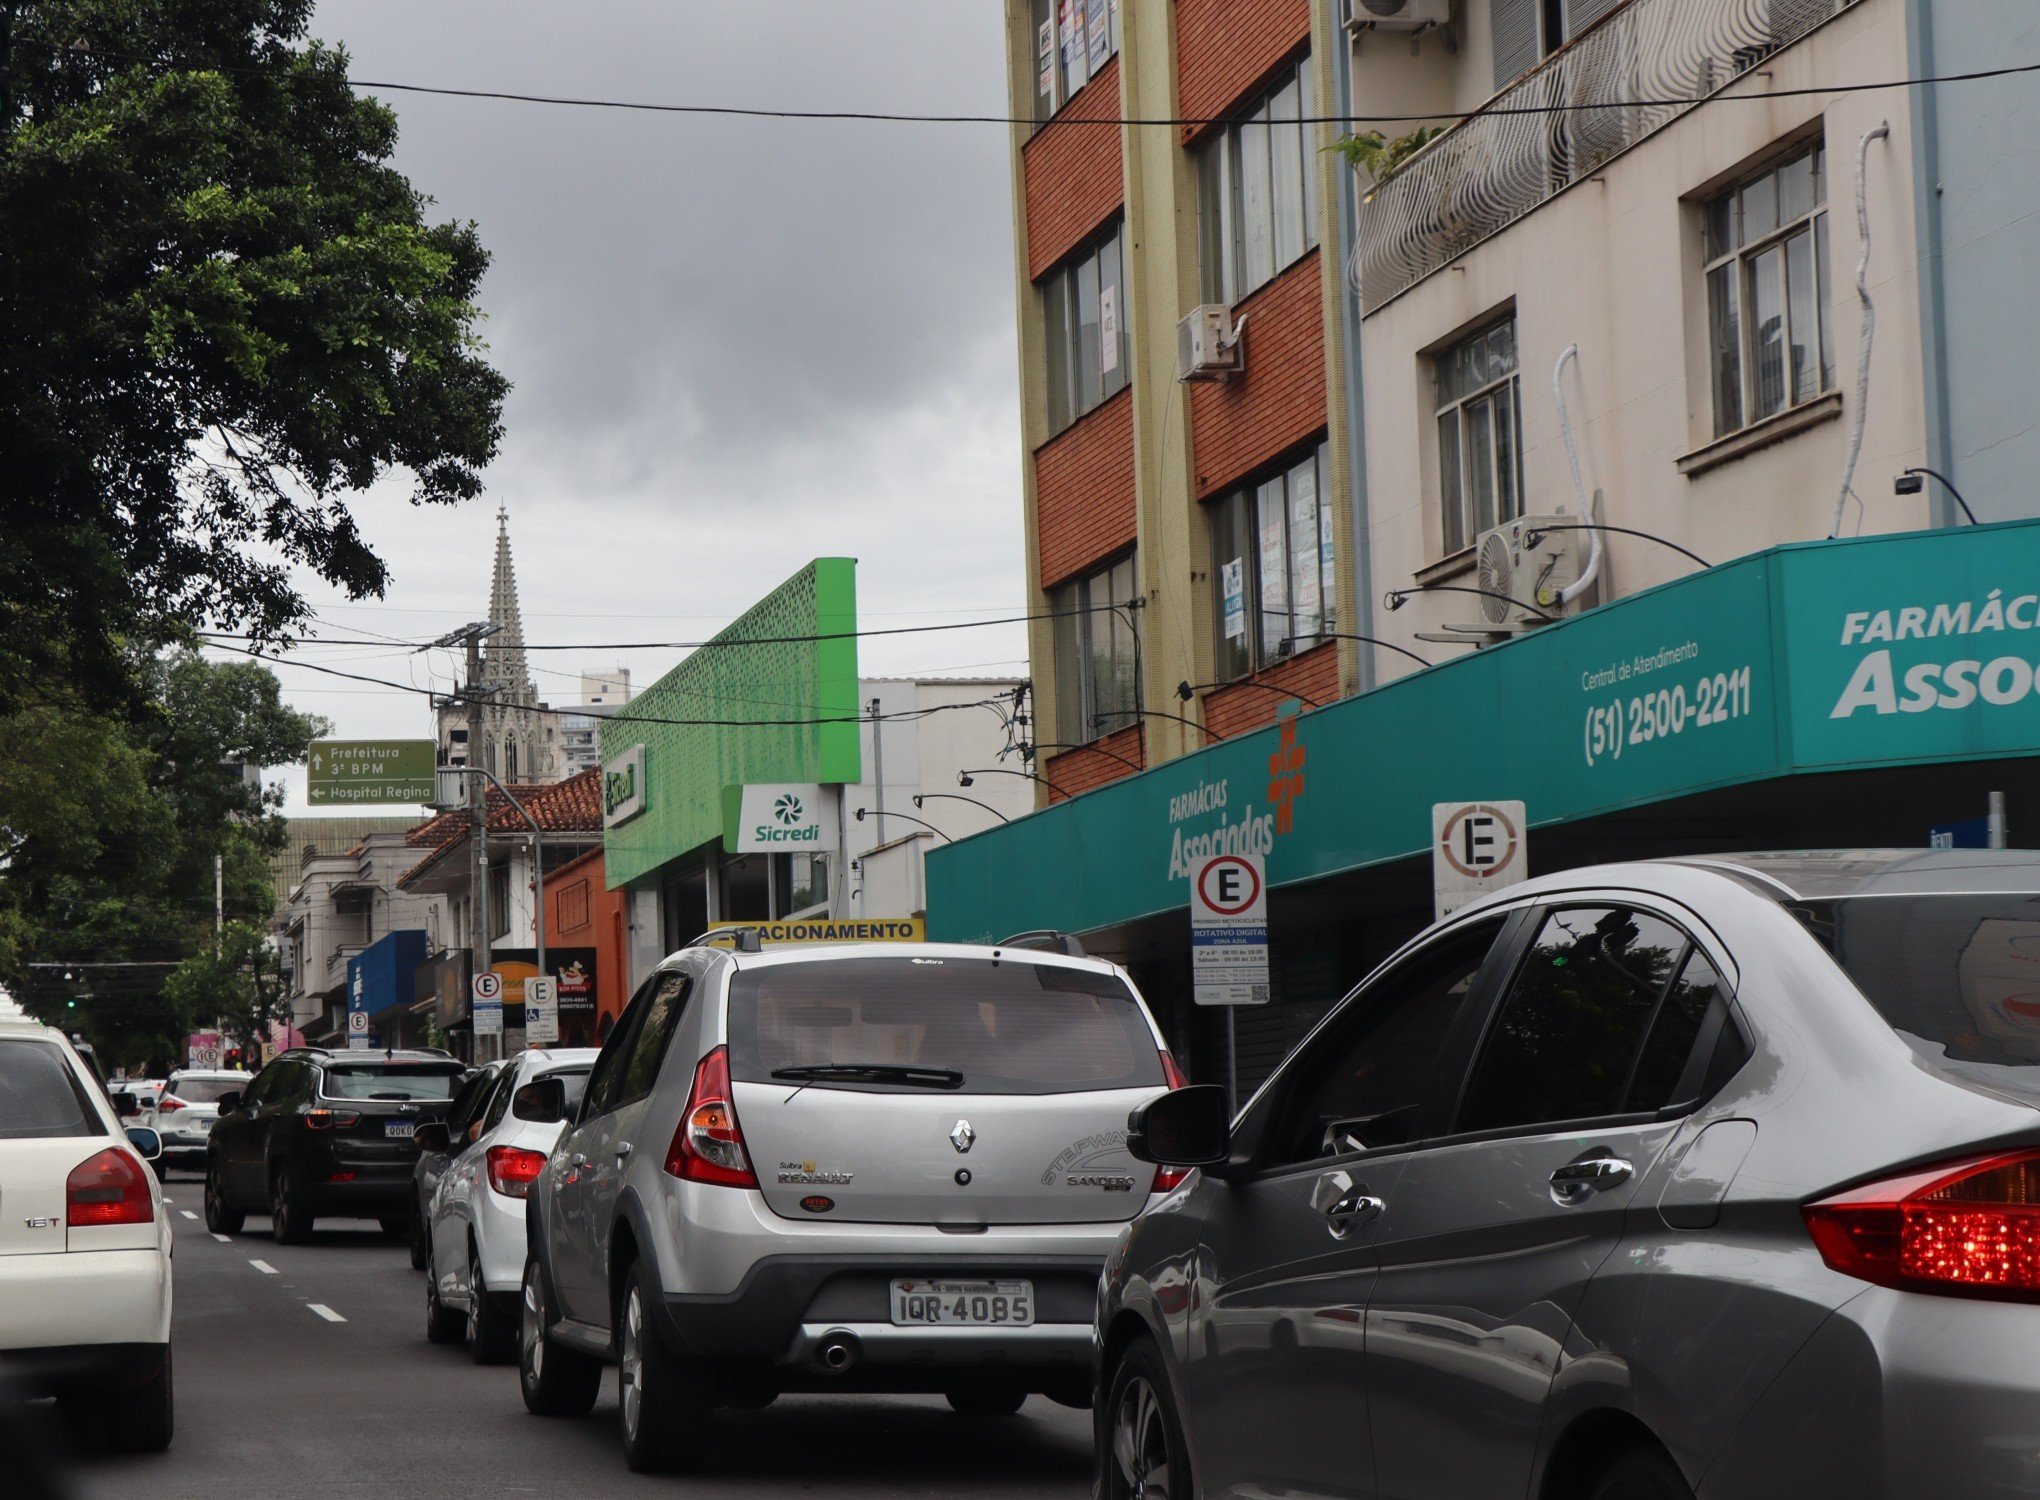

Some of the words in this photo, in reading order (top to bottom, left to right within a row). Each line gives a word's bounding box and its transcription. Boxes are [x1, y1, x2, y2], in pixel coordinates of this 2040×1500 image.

[1582, 663, 1617, 691] Central
[1619, 660, 1631, 680] de
[1633, 640, 1699, 676] Atendimento
[1829, 649, 2040, 719] ASSO
[1585, 698, 1624, 767] (51)
[1629, 666, 1750, 745] 2500-2211
[331, 747, 399, 759] Prefeitura
[330, 786, 382, 801] Hospital
[386, 785, 430, 799] Regina
[1169, 779, 1228, 824] FARMÁCIAS
[755, 824, 819, 842] Sicredi
[1465, 818, 1495, 865] E
[1218, 869, 1240, 902] E
[1194, 929, 1235, 937] ROTATIVO
[483, 978, 493, 993] E
[535, 982, 547, 1000] E
[400, 1103, 420, 1112] Jeep
[778, 1170, 855, 1185] RENAULT
[1067, 1175, 1136, 1186] SANDERO
